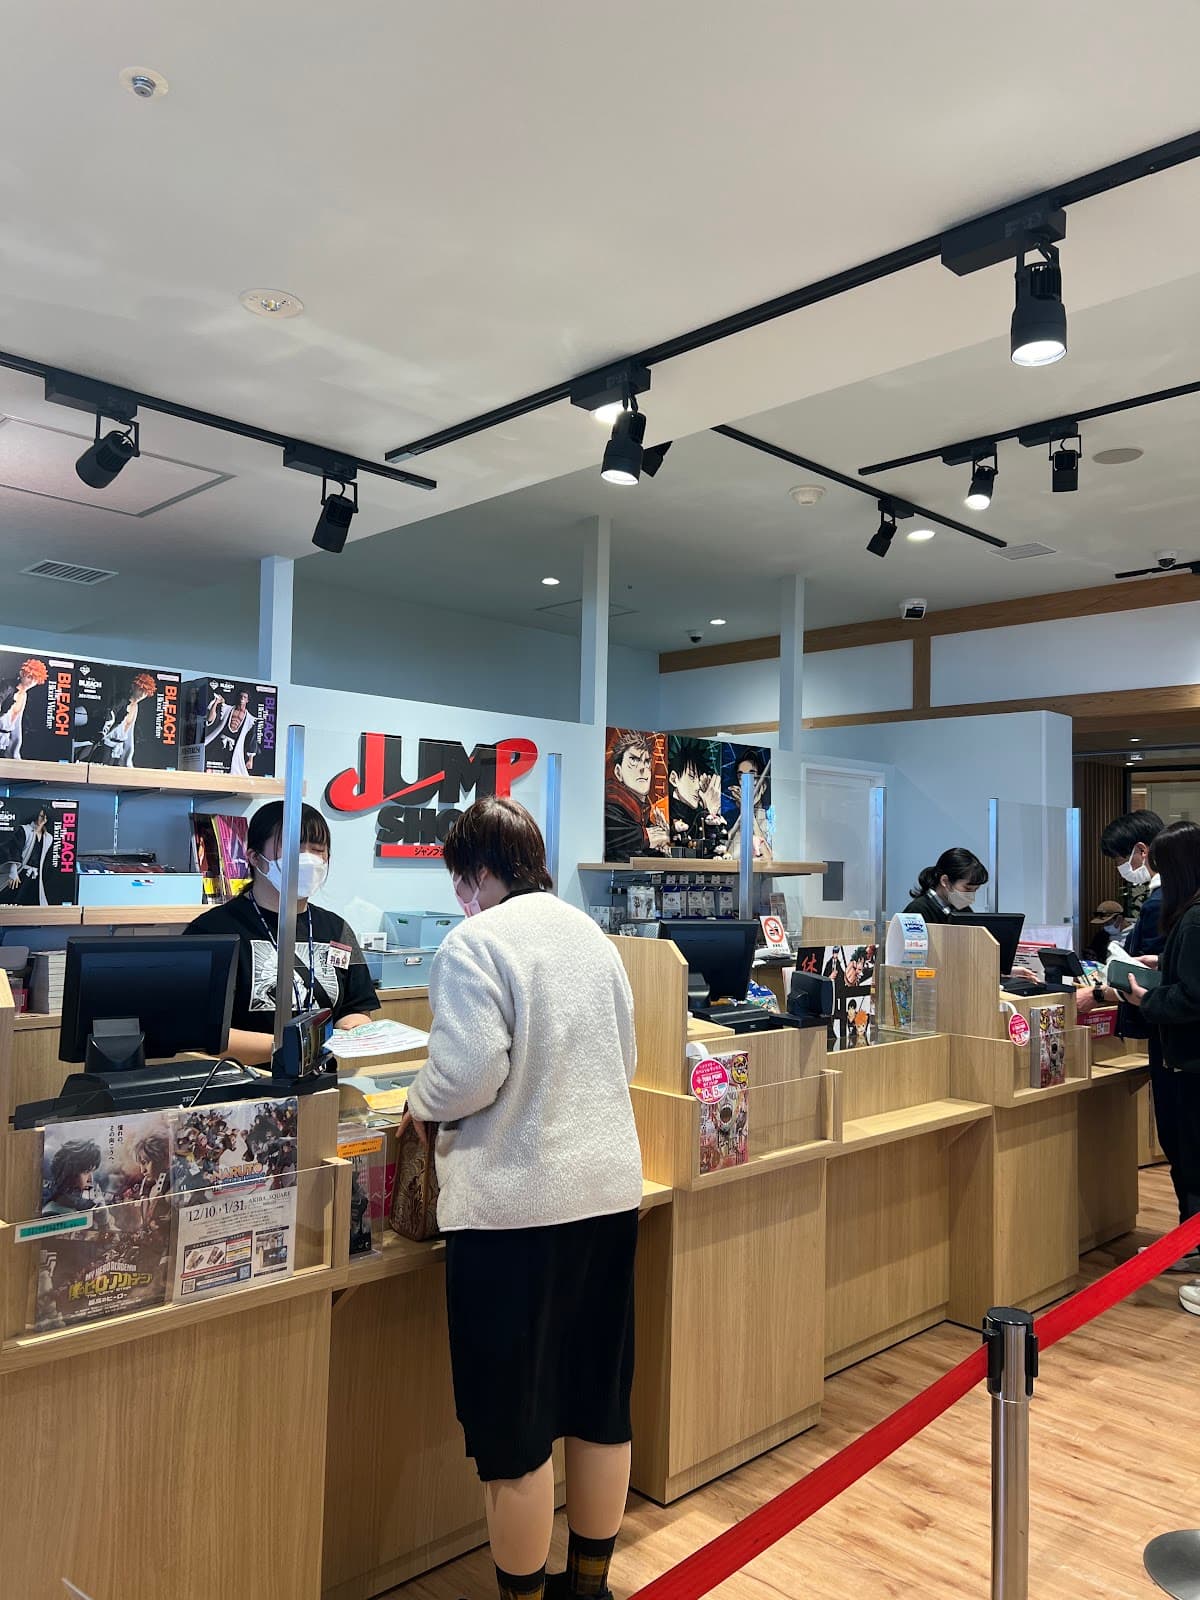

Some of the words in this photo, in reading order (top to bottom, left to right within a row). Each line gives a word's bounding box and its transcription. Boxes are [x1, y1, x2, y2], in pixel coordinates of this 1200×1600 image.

[55, 672, 71, 736] BLEACH
[163, 685, 178, 745] BLEACH
[263, 697, 275, 749] BLEACH
[326, 732, 538, 811] JUMP
[60, 813, 76, 873] BLEACH
[376, 805, 463, 845] SHO
[212, 1162, 264, 1181] NARUTO
[85, 1271, 96, 1281] MY
[95, 1262, 111, 1275] HERO
